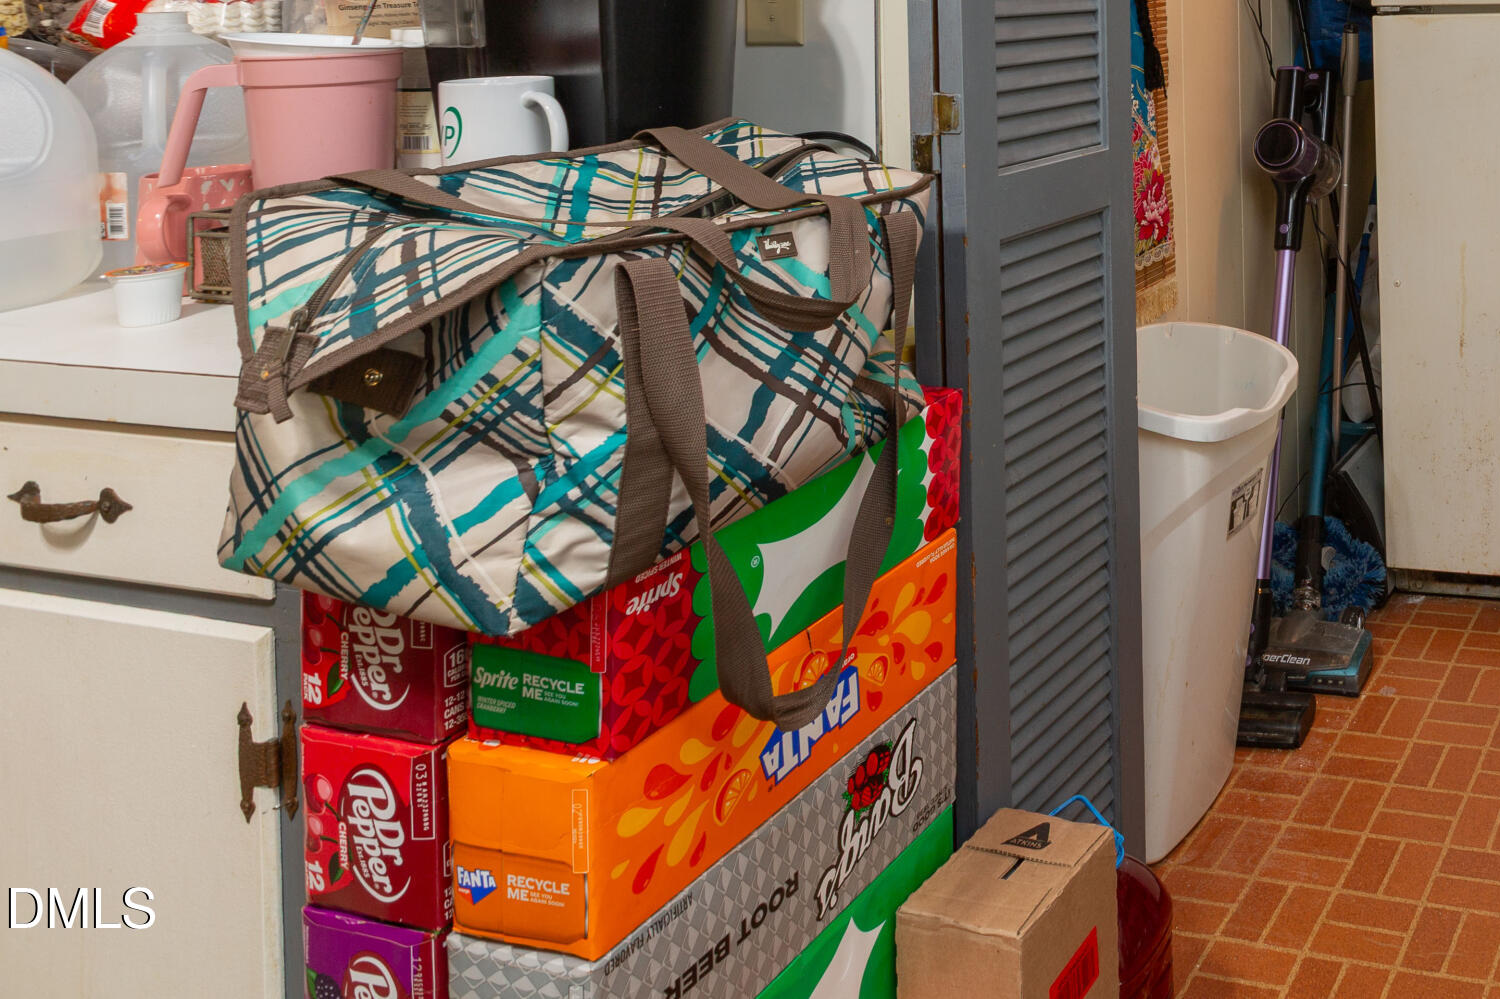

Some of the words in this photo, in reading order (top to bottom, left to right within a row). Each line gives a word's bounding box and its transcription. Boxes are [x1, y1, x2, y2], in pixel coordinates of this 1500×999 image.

[383, 2, 411, 10] Treasure
[635, 564, 657, 584] SPICED
[657, 552, 683, 571] WINTER
[625, 570, 684, 617] Sprite
[339, 631, 349, 682] CHERRY
[306, 671, 323, 706] 12
[473, 666, 519, 691] Sprite
[522, 672, 585, 695] RECYCLE
[476, 695, 497, 704] WINTER
[497, 699, 516, 709] SPICED
[521, 686, 544, 702] ME
[443, 704, 465, 720] CANS
[476, 702, 507, 714] CRANBERRY
[815, 717, 923, 923] Barq's
[912, 804, 937, 832] GOOD
[347, 769, 397, 895] Pepper
[375, 819, 405, 867] Dr
[1008, 837, 1042, 849] ATKINS
[337, 821, 349, 871] CHERRY
[308, 860, 326, 892] 12
[457, 865, 497, 891] FANTA
[507, 873, 570, 896] RECYCLE
[507, 886, 529, 902] ME
[737, 871, 800, 944] ROOT
[644, 889, 694, 946] ARTIFICIALLY
[603, 931, 645, 977] FLAVORED
[662, 930, 731, 999] BEER
